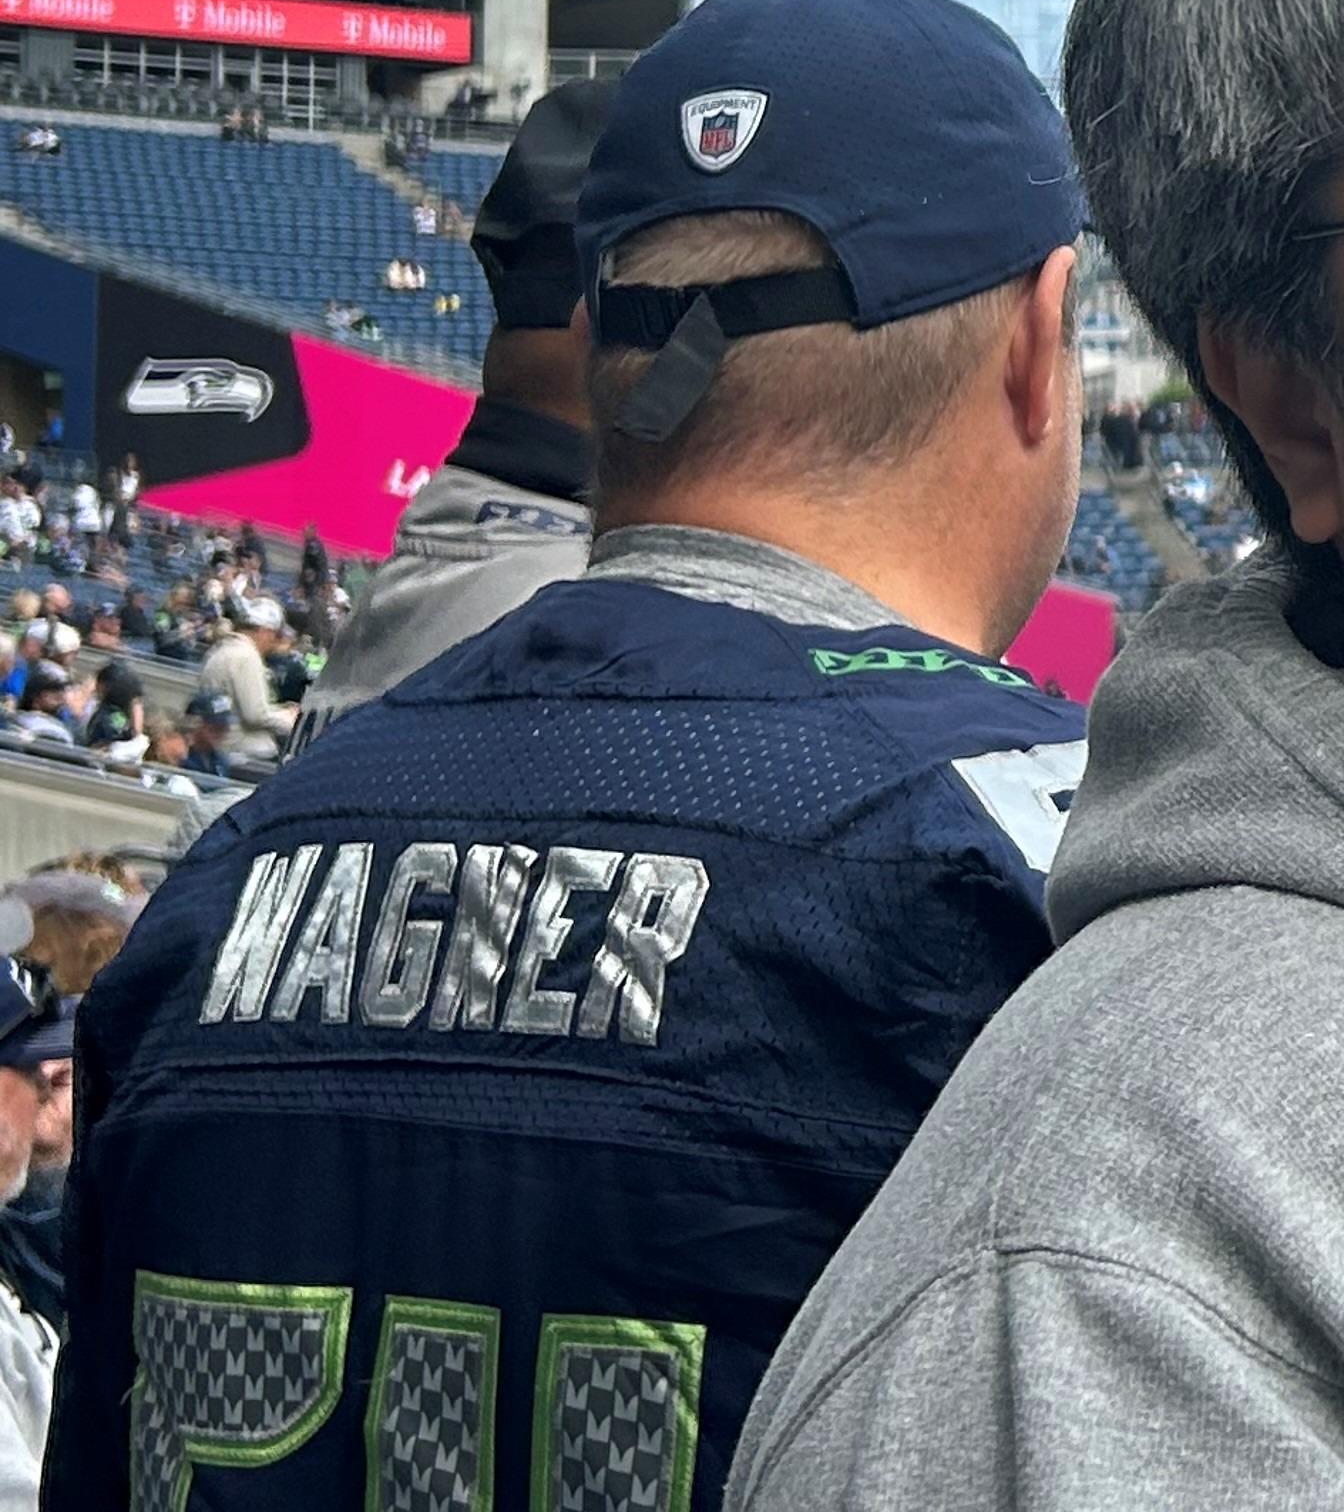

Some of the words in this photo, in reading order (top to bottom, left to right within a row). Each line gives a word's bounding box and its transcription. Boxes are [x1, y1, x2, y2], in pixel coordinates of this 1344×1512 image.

[202, 0, 287, 40] Mobile
[369, 15, 446, 52] Mobile
[703, 130, 733, 151] NFL
[200, 841, 710, 1047] WAGNER
